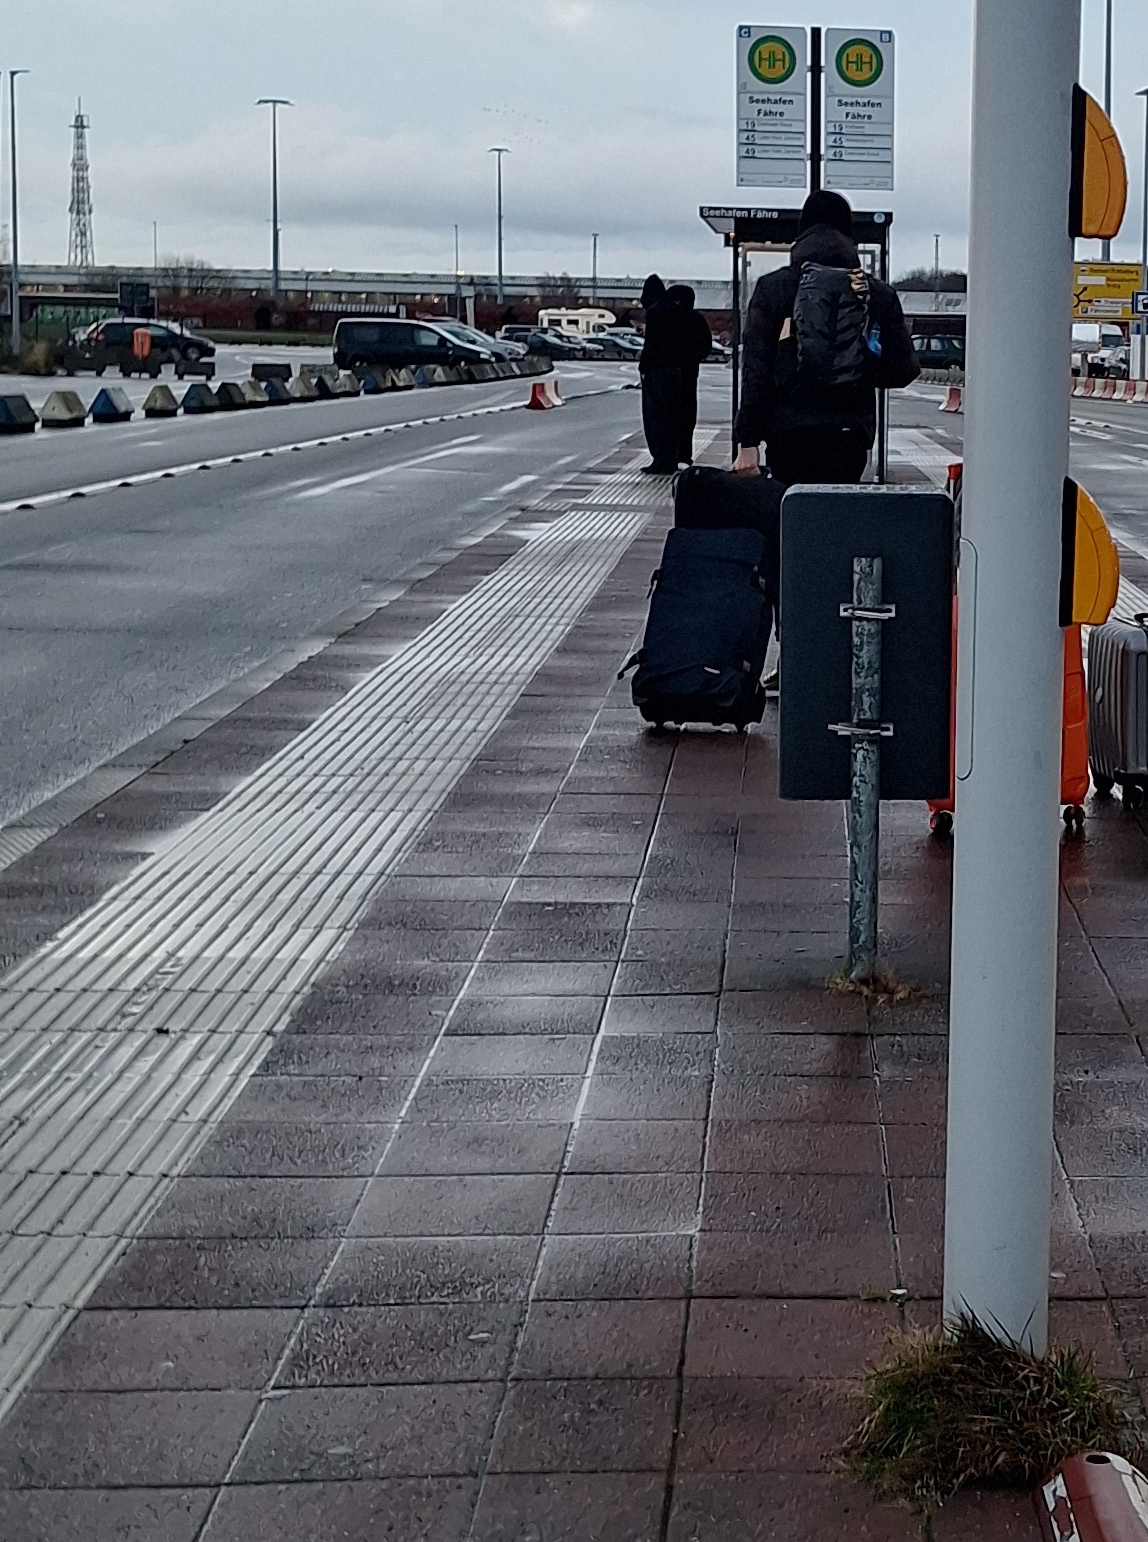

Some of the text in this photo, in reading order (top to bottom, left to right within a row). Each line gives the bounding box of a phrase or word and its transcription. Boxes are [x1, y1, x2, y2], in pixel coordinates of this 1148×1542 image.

[740, 28, 749, 37] C
[748, 95, 794, 106] Seehafen
[837, 98, 882, 109] Seehafen
[757, 108, 785, 118] Fähre
[845, 111, 872, 121] Fähre
[745, 121, 755, 129] 19
[833, 123, 843, 131] 19
[744, 134, 756, 142] 45
[832, 136, 843, 145] 45
[744, 147, 756, 156] 49
[832, 150, 843, 158] 49
[702, 207, 779, 219] Seehafen Fähre
